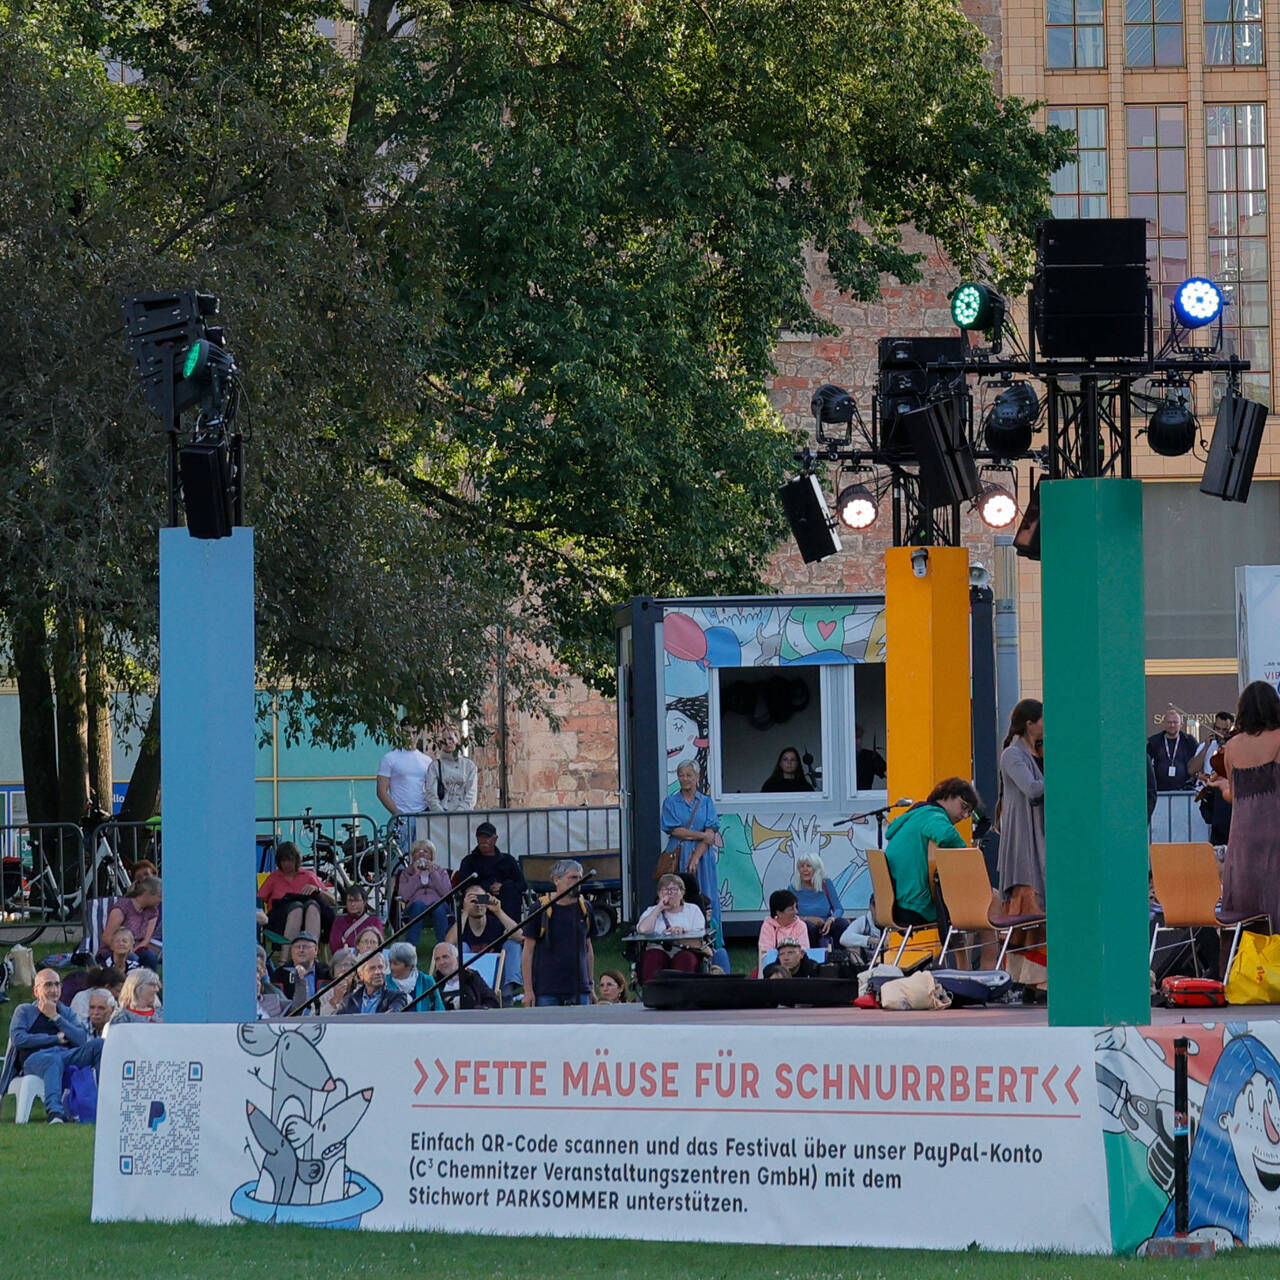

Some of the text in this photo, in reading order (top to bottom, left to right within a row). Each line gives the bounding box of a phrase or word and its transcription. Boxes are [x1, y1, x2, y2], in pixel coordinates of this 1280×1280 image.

[563, 1048, 679, 1097] MÄUSE
[695, 1049, 760, 1098] FÜR
[410, 1131, 1043, 1168] Einfach QR-Code scannen und das Festival über unser PayPal-Konto
[437, 1159, 538, 1181] Chemnitzer
[543, 1161, 750, 1189] Veranstaltungszentren
[757, 1163, 818, 1190] GmbH)
[824, 1166, 856, 1188] mit
[862, 1168, 902, 1189] dem
[408, 1185, 748, 1213] Stichwort PARKSOMMER unterstützen.
